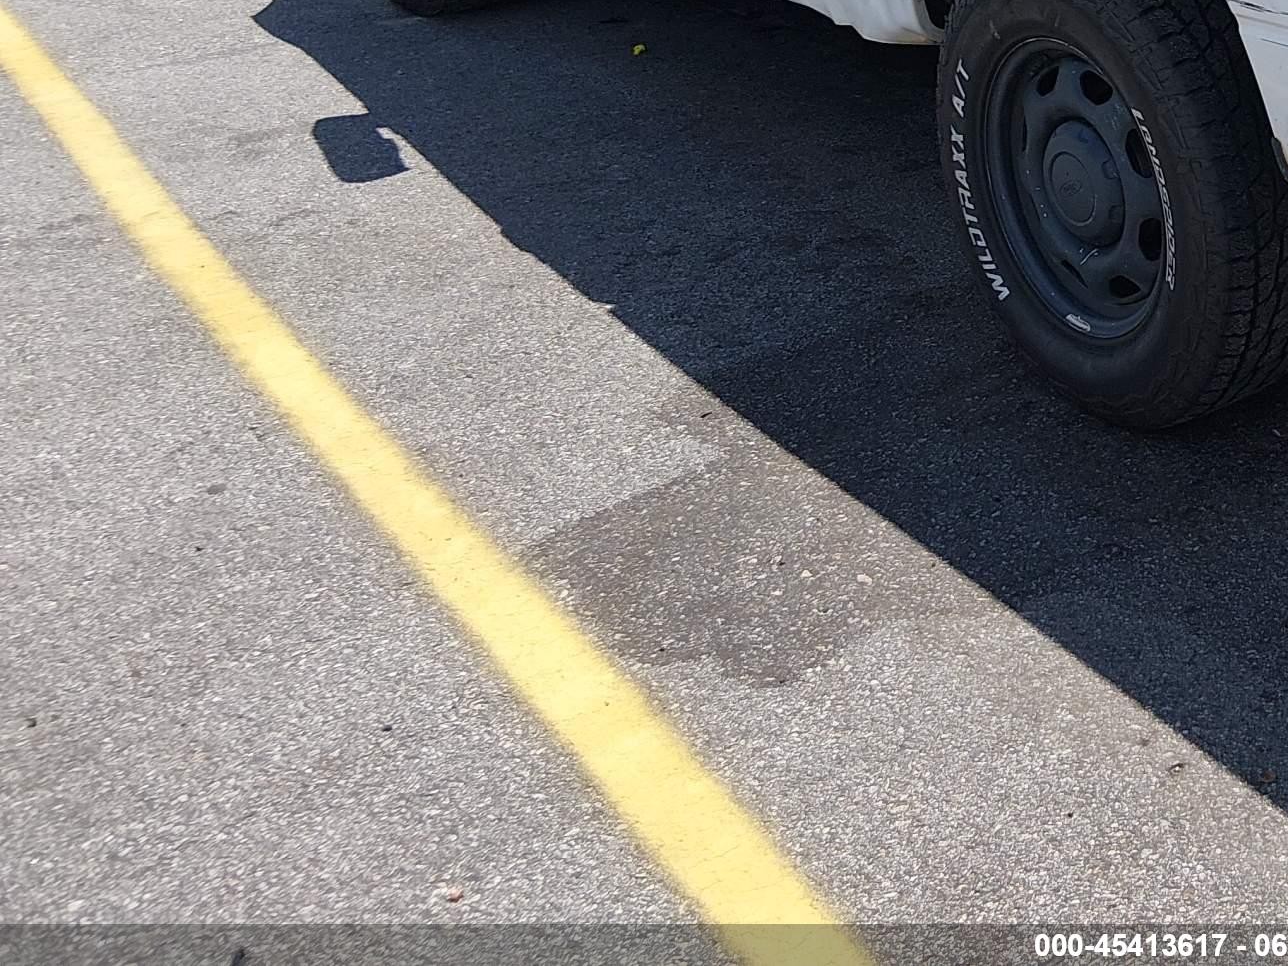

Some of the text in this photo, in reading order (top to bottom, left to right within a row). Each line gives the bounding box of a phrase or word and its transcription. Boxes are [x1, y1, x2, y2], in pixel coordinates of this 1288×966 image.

[951, 58, 1011, 301] WILDTRAXX A/T
[1130, 107, 1177, 291] LANDSPIDER
